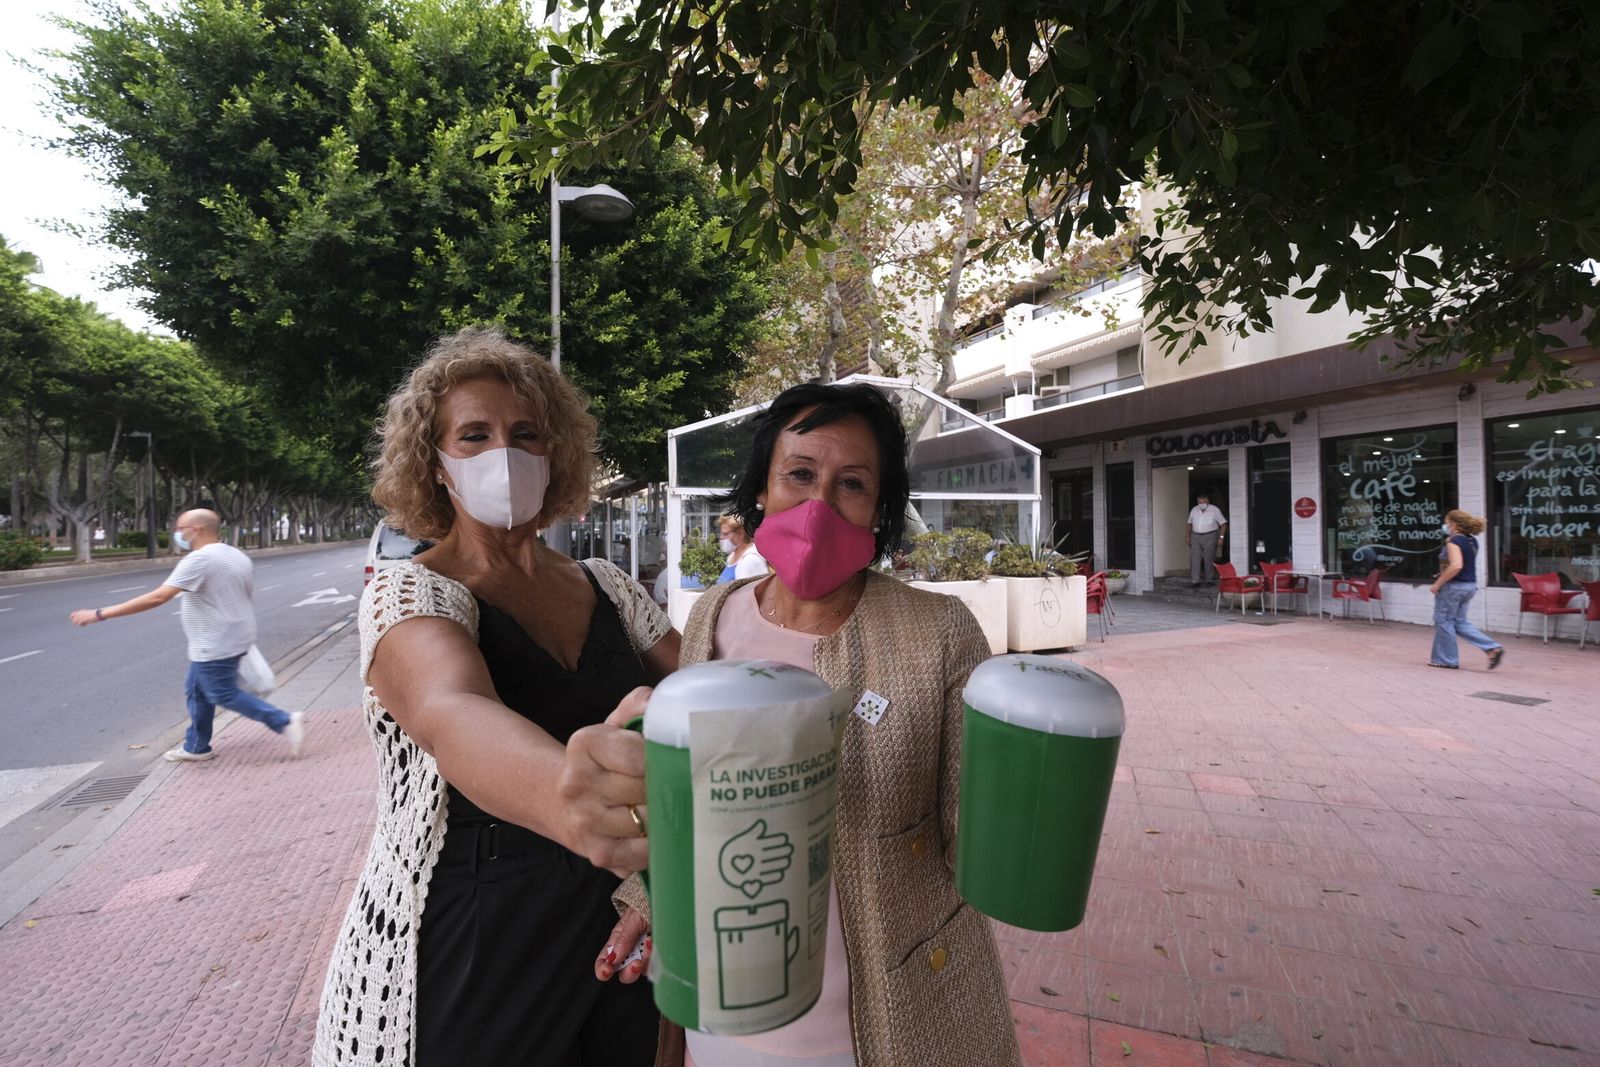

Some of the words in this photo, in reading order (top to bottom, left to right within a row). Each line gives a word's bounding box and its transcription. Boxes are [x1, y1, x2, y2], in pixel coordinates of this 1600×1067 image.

[1525, 437, 1554, 461] El
[1338, 455, 1355, 474] el
[1363, 449, 1421, 473] mejor
[937, 460, 1017, 490] FARMACIA
[1496, 470, 1515, 482] es
[1527, 485, 1573, 506] para
[1579, 477, 1597, 497] la
[1341, 505, 1354, 514] no
[1359, 500, 1382, 513] vale
[1384, 500, 1401, 513] de
[1403, 498, 1437, 512] nada
[1511, 504, 1533, 516] sin
[1536, 501, 1564, 515] ella
[1568, 504, 1588, 514] no
[1338, 516, 1348, 527] si
[1352, 517, 1366, 527] no
[1401, 516, 1417, 525] en
[1519, 516, 1590, 540] hacer
[1398, 529, 1442, 540] manos
[710, 769, 731, 783] LA
[710, 787, 737, 801] NO
[742, 778, 800, 801] PUEDE
